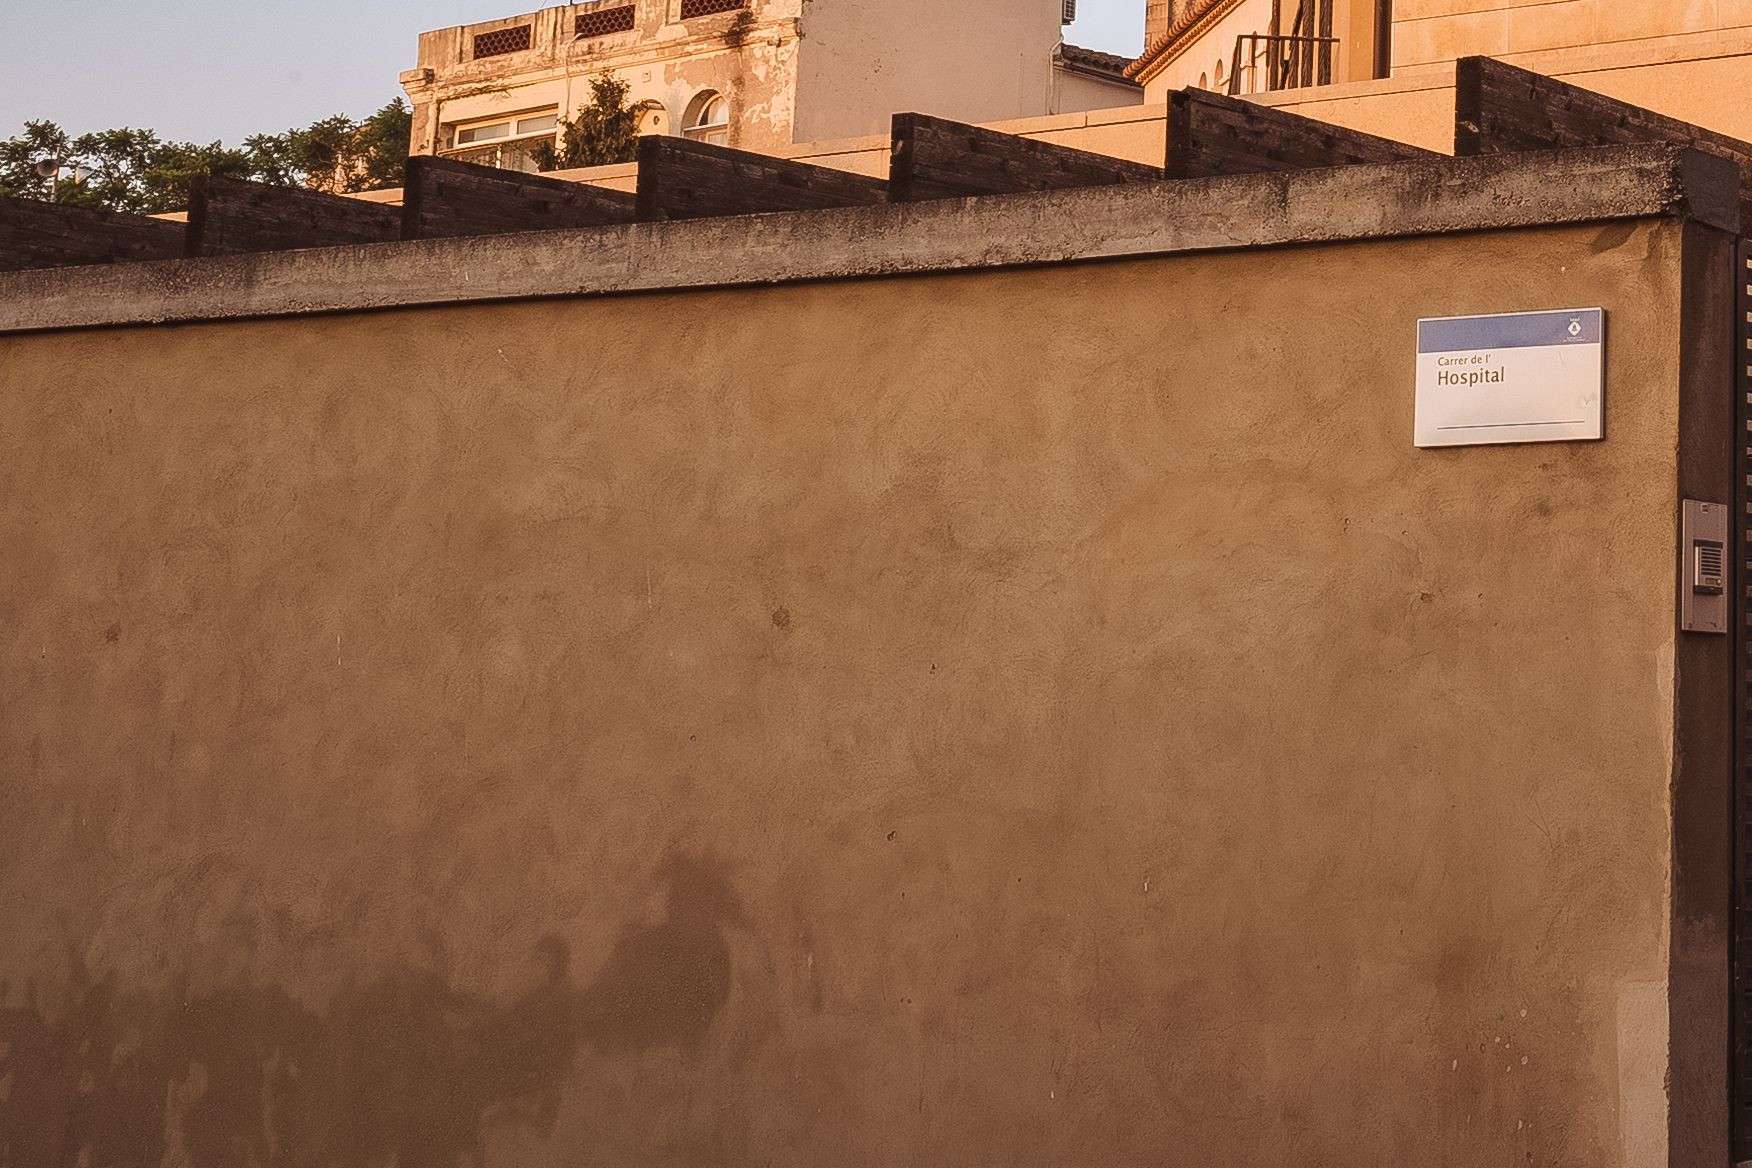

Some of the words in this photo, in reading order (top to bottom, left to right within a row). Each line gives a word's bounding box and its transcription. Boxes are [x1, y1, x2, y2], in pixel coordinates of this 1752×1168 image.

[1438, 356, 1468, 367] Carrer
[1470, 354, 1483, 364] de
[1485, 353, 1491, 364] l'
[1437, 365, 1505, 387] Hospital
